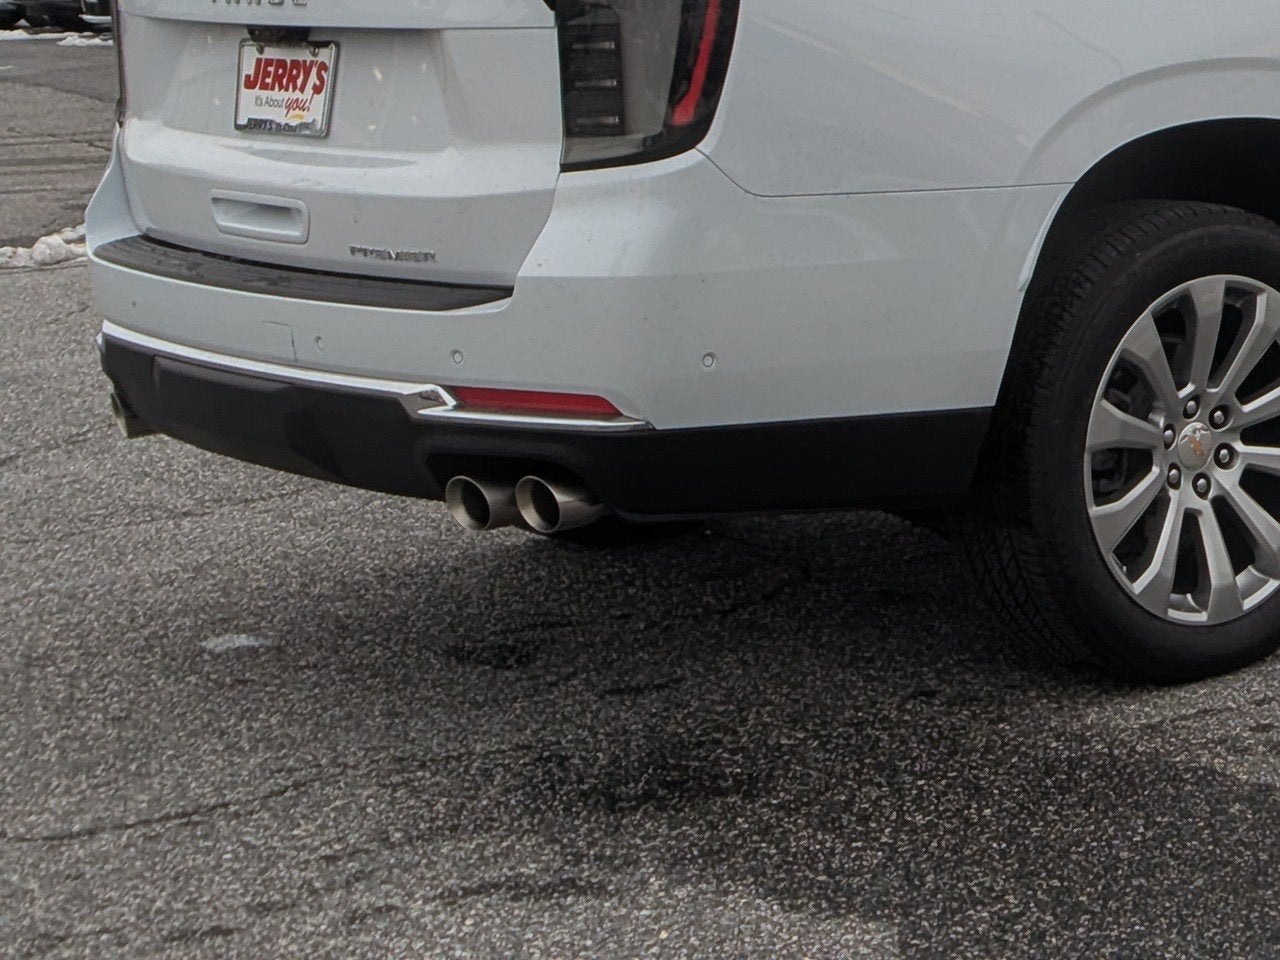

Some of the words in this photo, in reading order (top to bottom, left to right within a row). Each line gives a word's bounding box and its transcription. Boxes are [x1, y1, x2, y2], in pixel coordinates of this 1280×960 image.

[244, 57, 329, 95] JERRY'S
[264, 96, 285, 109] About
[284, 91, 315, 118] you!
